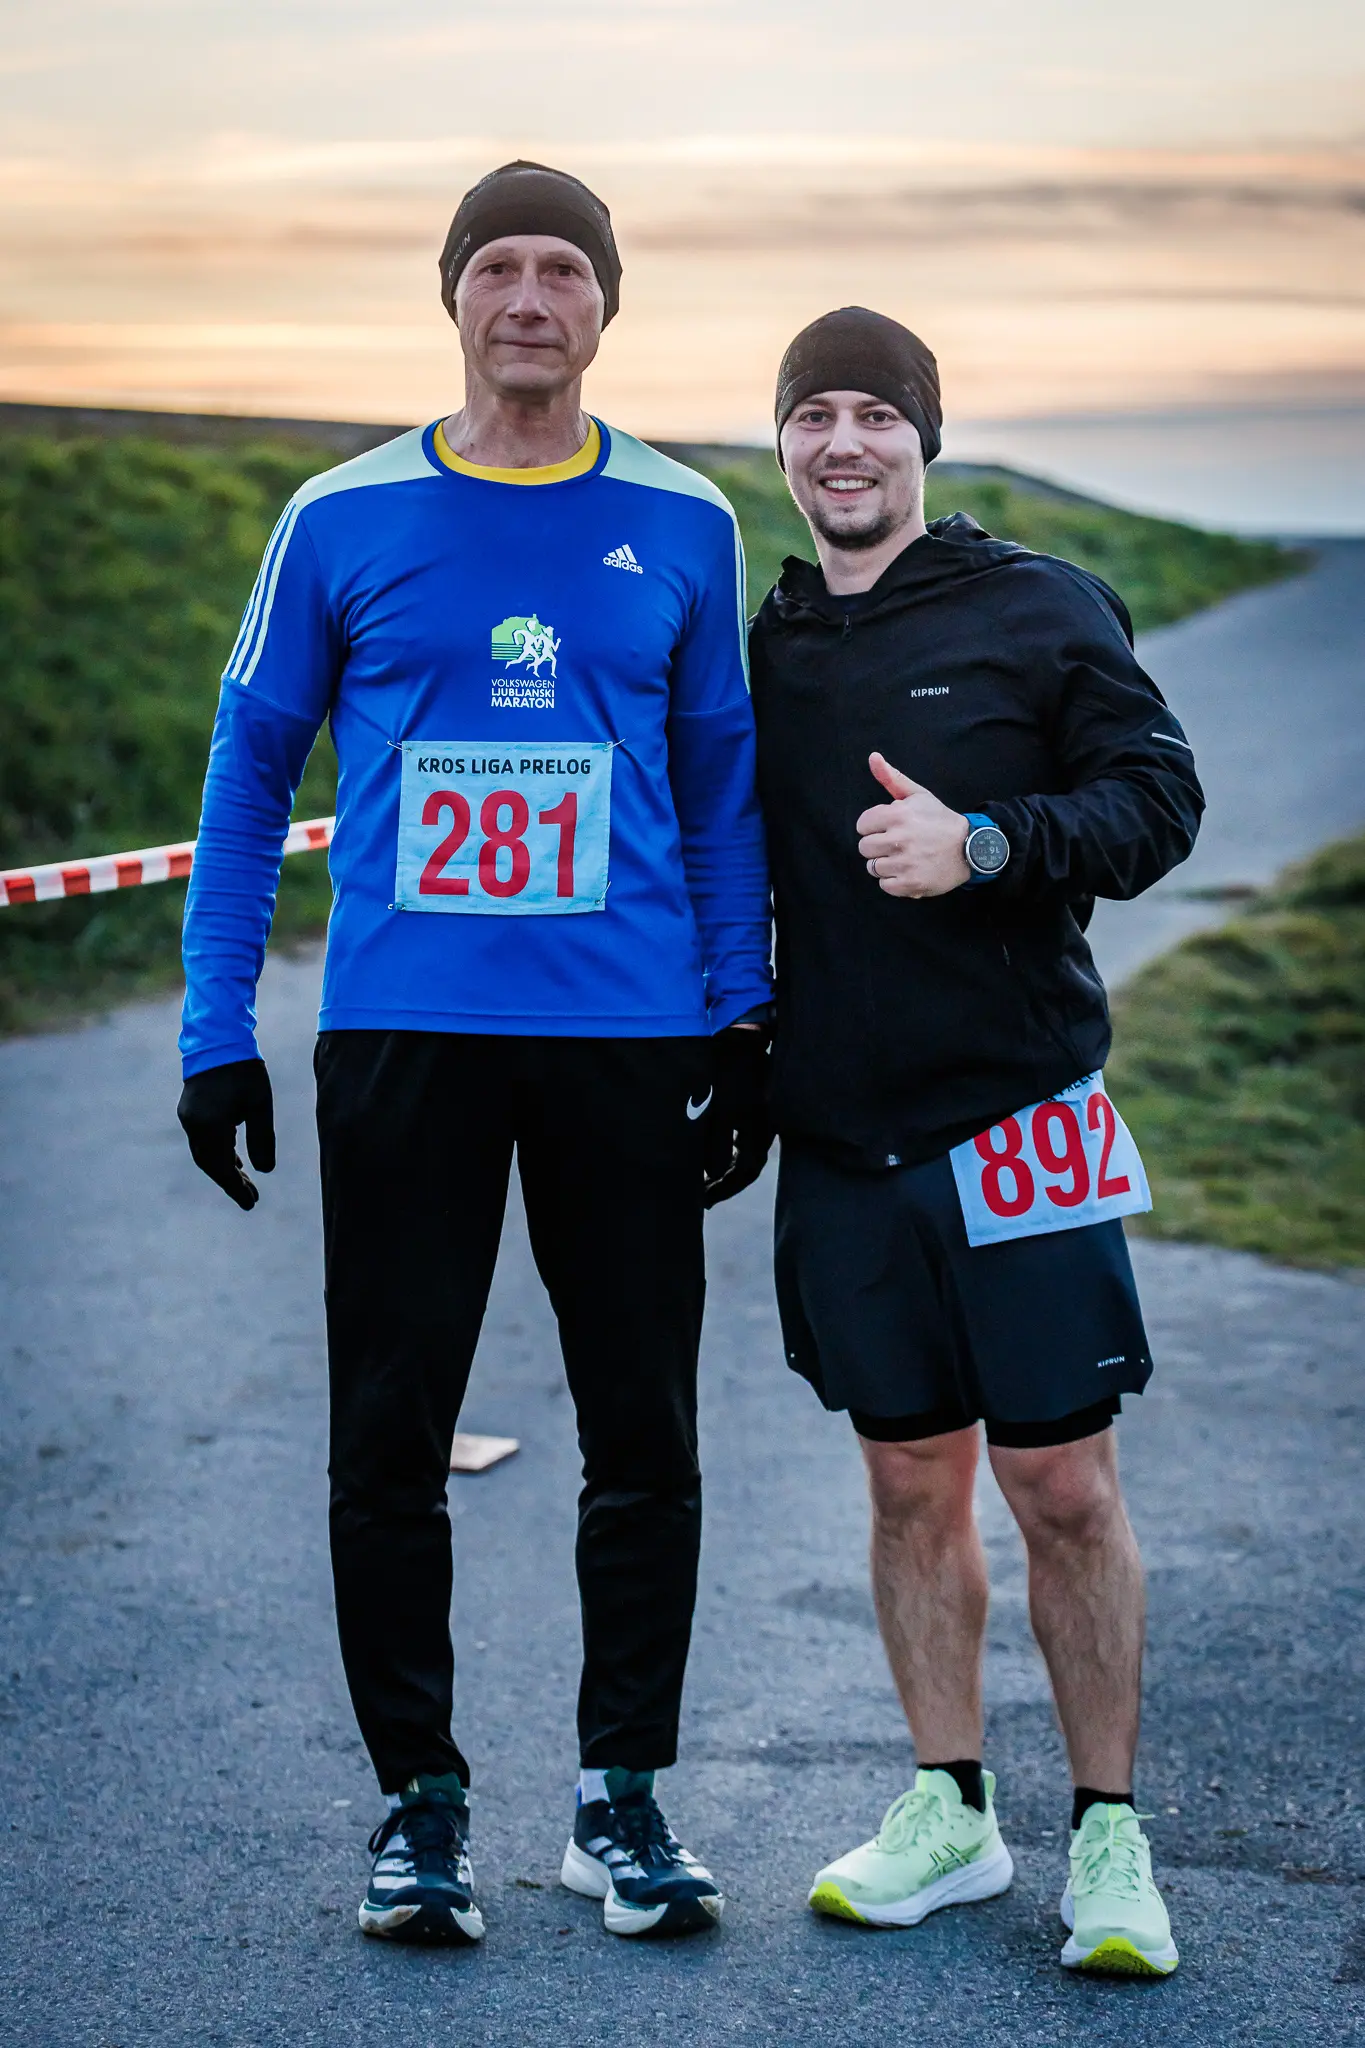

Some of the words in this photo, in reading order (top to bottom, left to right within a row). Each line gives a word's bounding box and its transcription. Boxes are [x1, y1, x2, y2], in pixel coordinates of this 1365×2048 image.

[602, 556, 644, 575] adidas
[491, 679, 555, 689] VOLKSWAGEN
[491, 688, 555, 698] LJUBLJANSKI
[910, 686, 950, 698] KIPRUN
[491, 697, 555, 709] MARATON
[417, 757, 465, 774] KROS
[471, 758, 514, 775] LIGA
[519, 758, 591, 775] PRELOG
[418, 789, 578, 898] 281
[973, 1092, 1131, 1217] 892
[1097, 1355, 1125, 1368] KIPRUN
